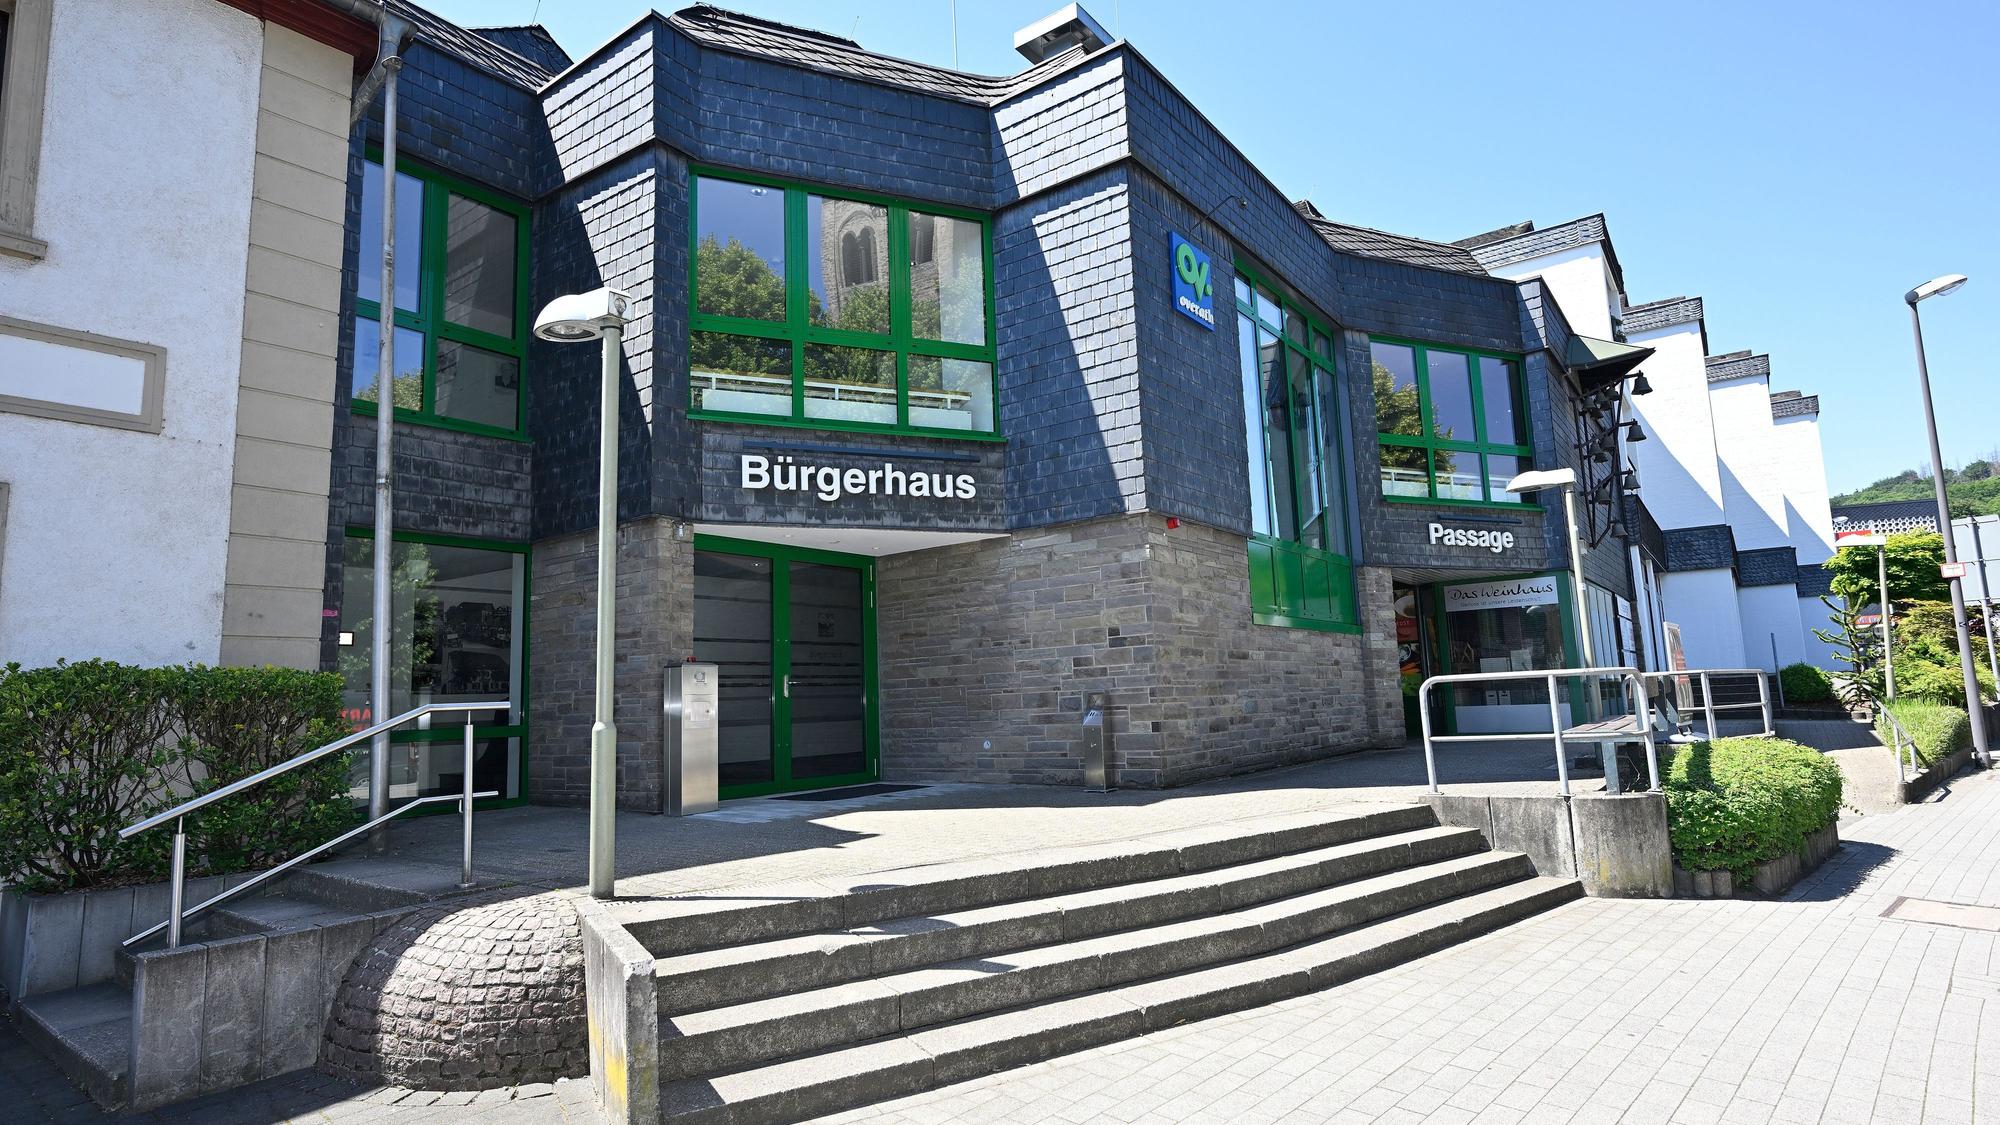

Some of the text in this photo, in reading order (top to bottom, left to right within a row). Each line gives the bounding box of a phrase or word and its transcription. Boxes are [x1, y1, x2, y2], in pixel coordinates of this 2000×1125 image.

[741, 454, 977, 502] Bürgerhaus
[1428, 522, 1514, 553] Passage
[1450, 583, 1554, 601] Das Weinhaus
